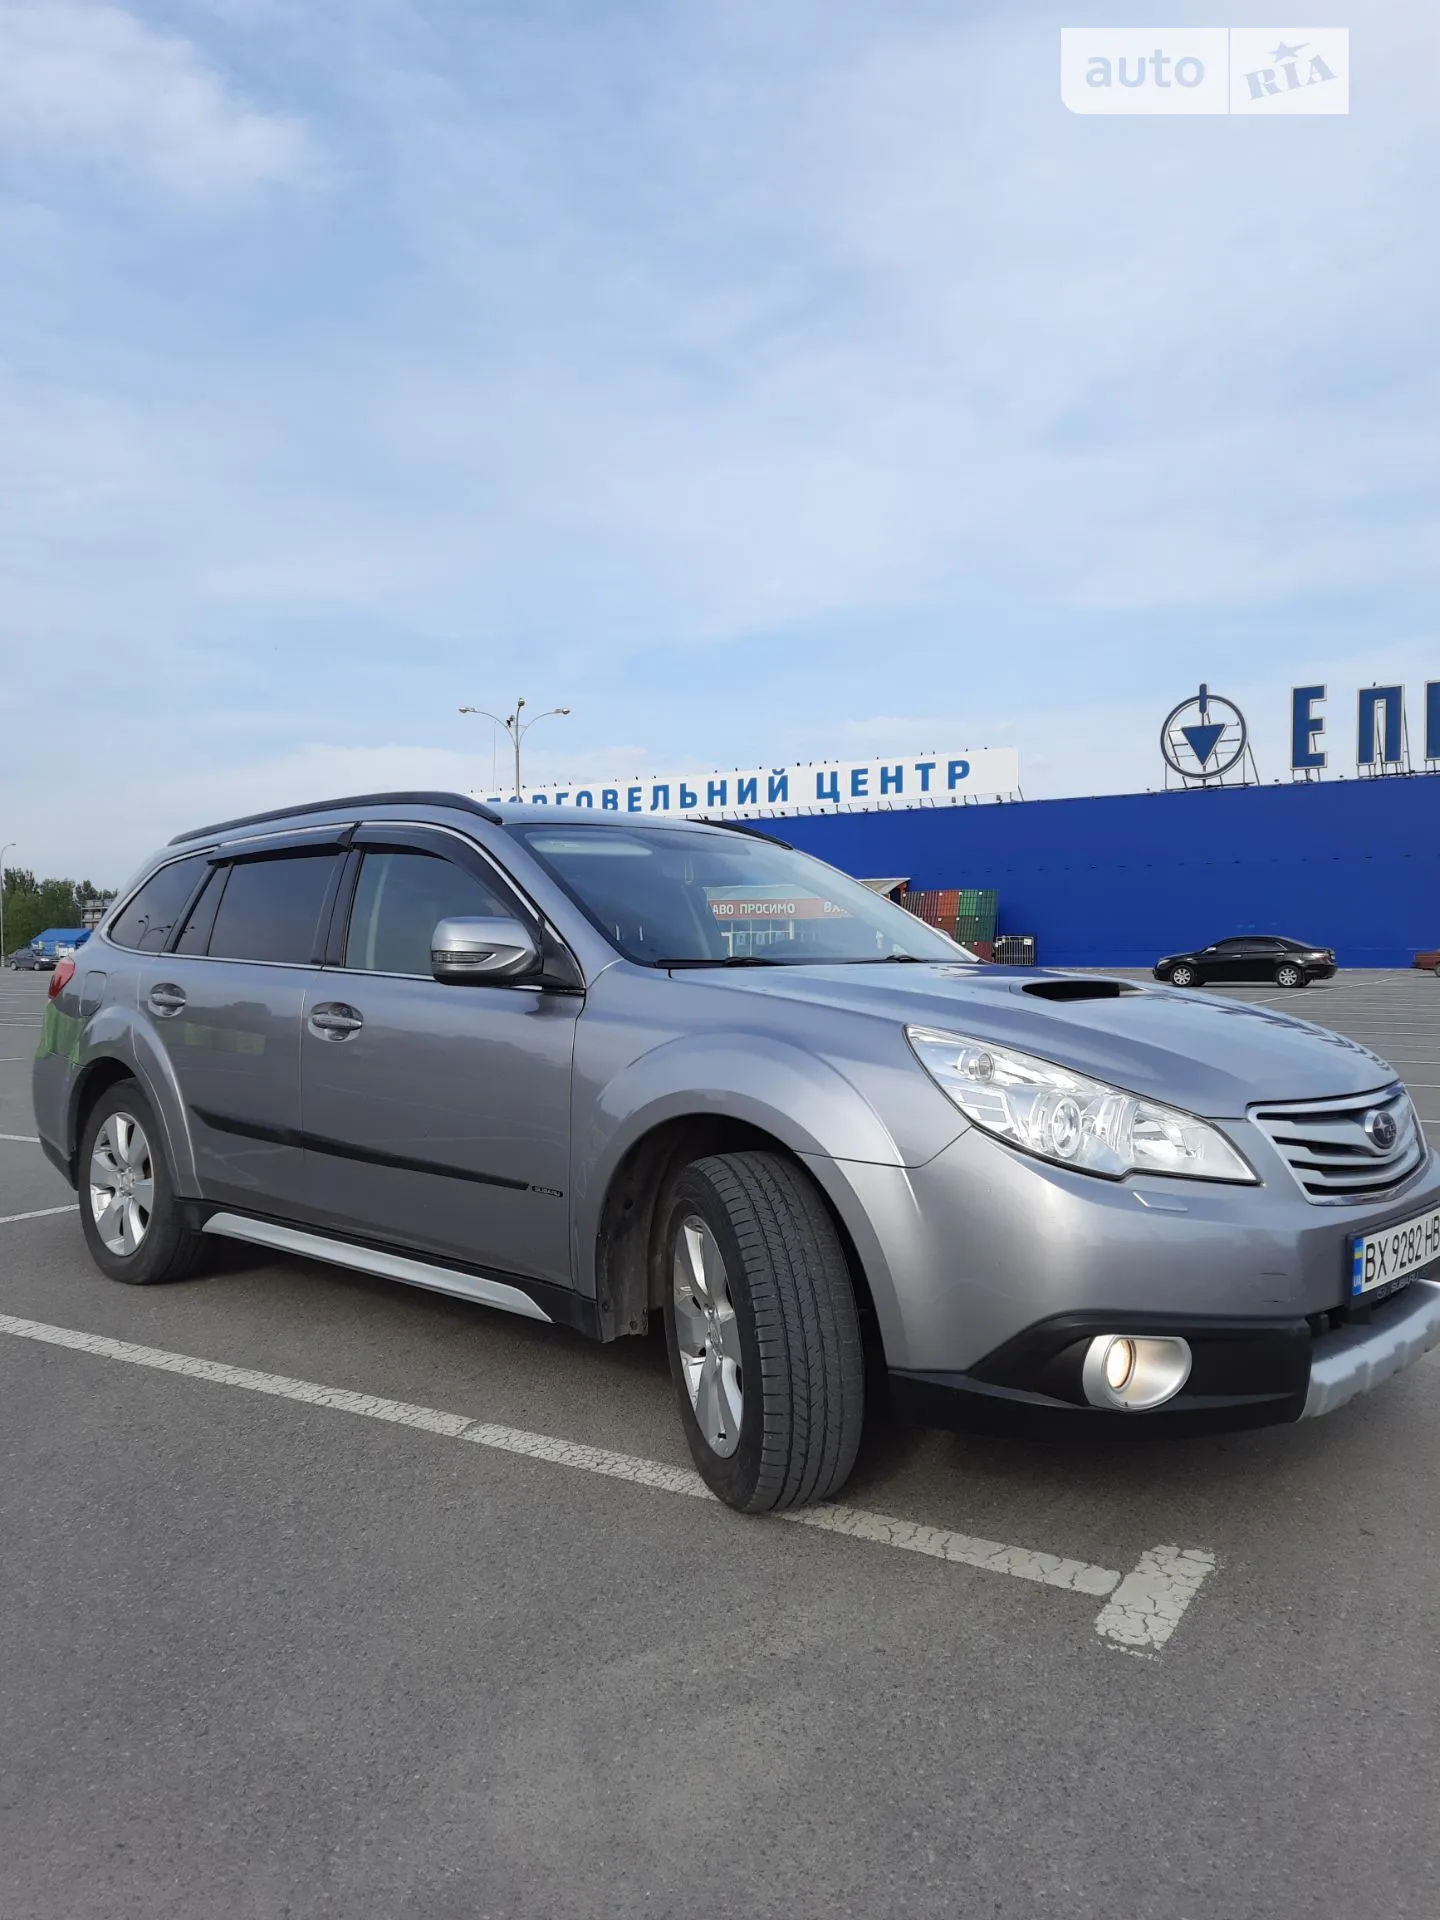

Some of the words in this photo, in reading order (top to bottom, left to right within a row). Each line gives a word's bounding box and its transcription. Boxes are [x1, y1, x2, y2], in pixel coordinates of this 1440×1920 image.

[487, 768, 788, 813] ГОВЕЛЬНИЙ
[816, 759, 970, 803] ЦЕНТР
[739, 903, 796, 914] ПРОСИМО
